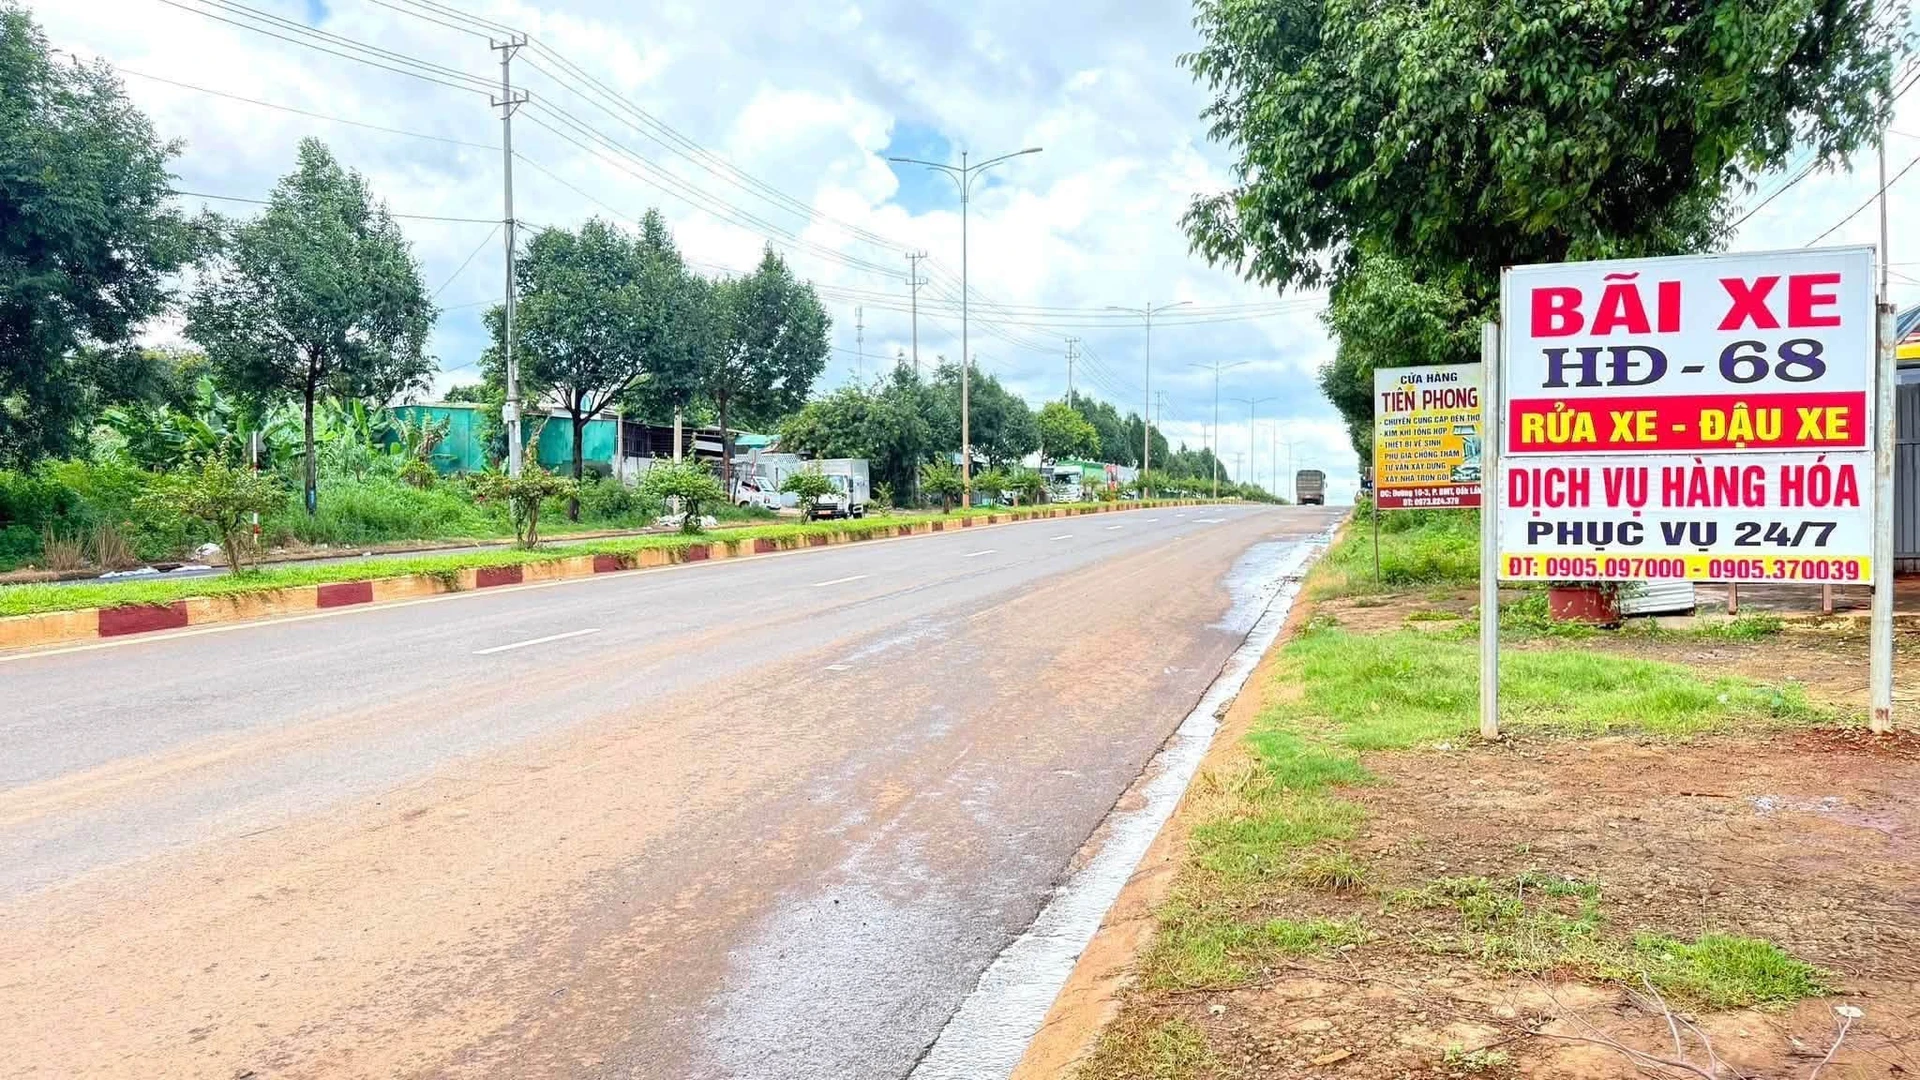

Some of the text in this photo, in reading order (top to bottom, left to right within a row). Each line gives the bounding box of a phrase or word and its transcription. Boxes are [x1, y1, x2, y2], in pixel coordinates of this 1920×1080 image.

[1531, 272, 1841, 338] BÃI XE
[1401, 372, 1457, 384] CỬA HÀNG
[1542, 338, 1826, 388] HĐ - 68
[1423, 387, 1478, 410] PHONG
[1521, 402, 1597, 443] RỬA
[1609, 410, 1658, 442] XE
[1699, 401, 1781, 448] ĐẬU
[1796, 407, 1849, 440] XE
[1508, 455, 1860, 517] DỊCH VỤ HÀNG HÓA
[1527, 521, 1838, 551] PHỤC VỤ 24/7
[1509, 557, 1539, 577] ĐT:
[1546, 558, 1685, 578] 0905.097000
[1709, 559, 1860, 579] 0905.370039
